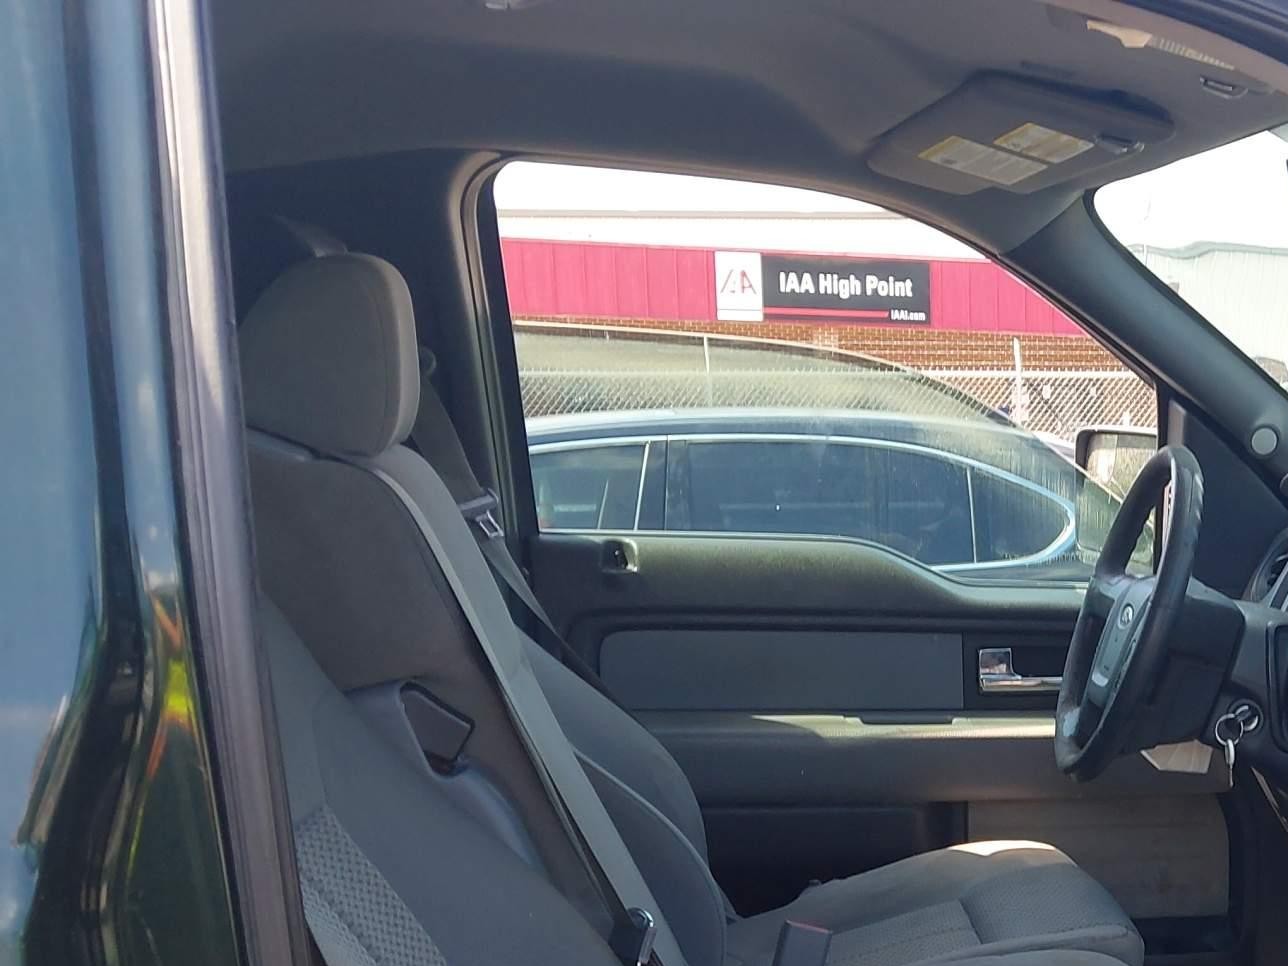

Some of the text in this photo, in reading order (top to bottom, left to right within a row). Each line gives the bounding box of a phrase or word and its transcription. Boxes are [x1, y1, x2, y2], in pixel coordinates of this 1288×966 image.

[779, 271, 913, 299] IAA High Point
